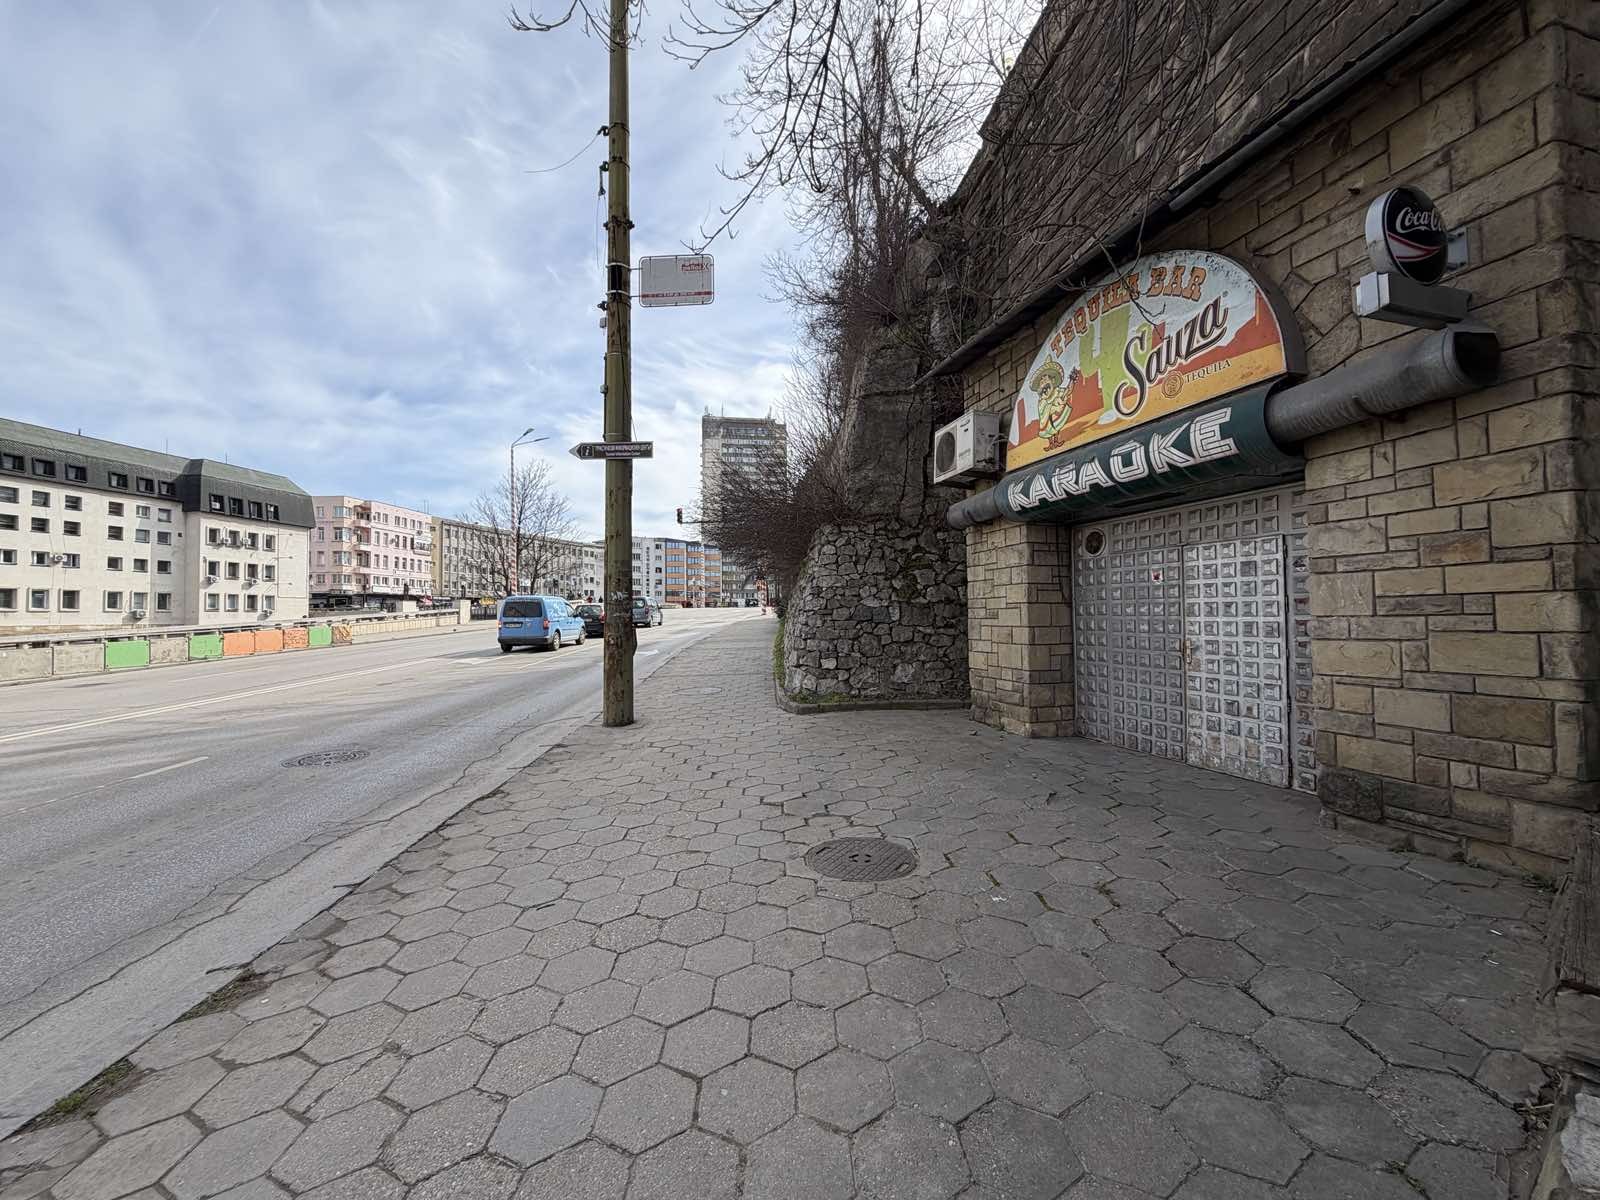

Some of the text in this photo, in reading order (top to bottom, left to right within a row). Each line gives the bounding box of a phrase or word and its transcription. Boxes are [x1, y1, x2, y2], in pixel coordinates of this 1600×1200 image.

[1147, 265, 1207, 302] BAR
[1113, 296, 1229, 417] Sauza
[1184, 360, 1231, 384] TEQUILA
[1007, 407, 1240, 512] KARAOKE
